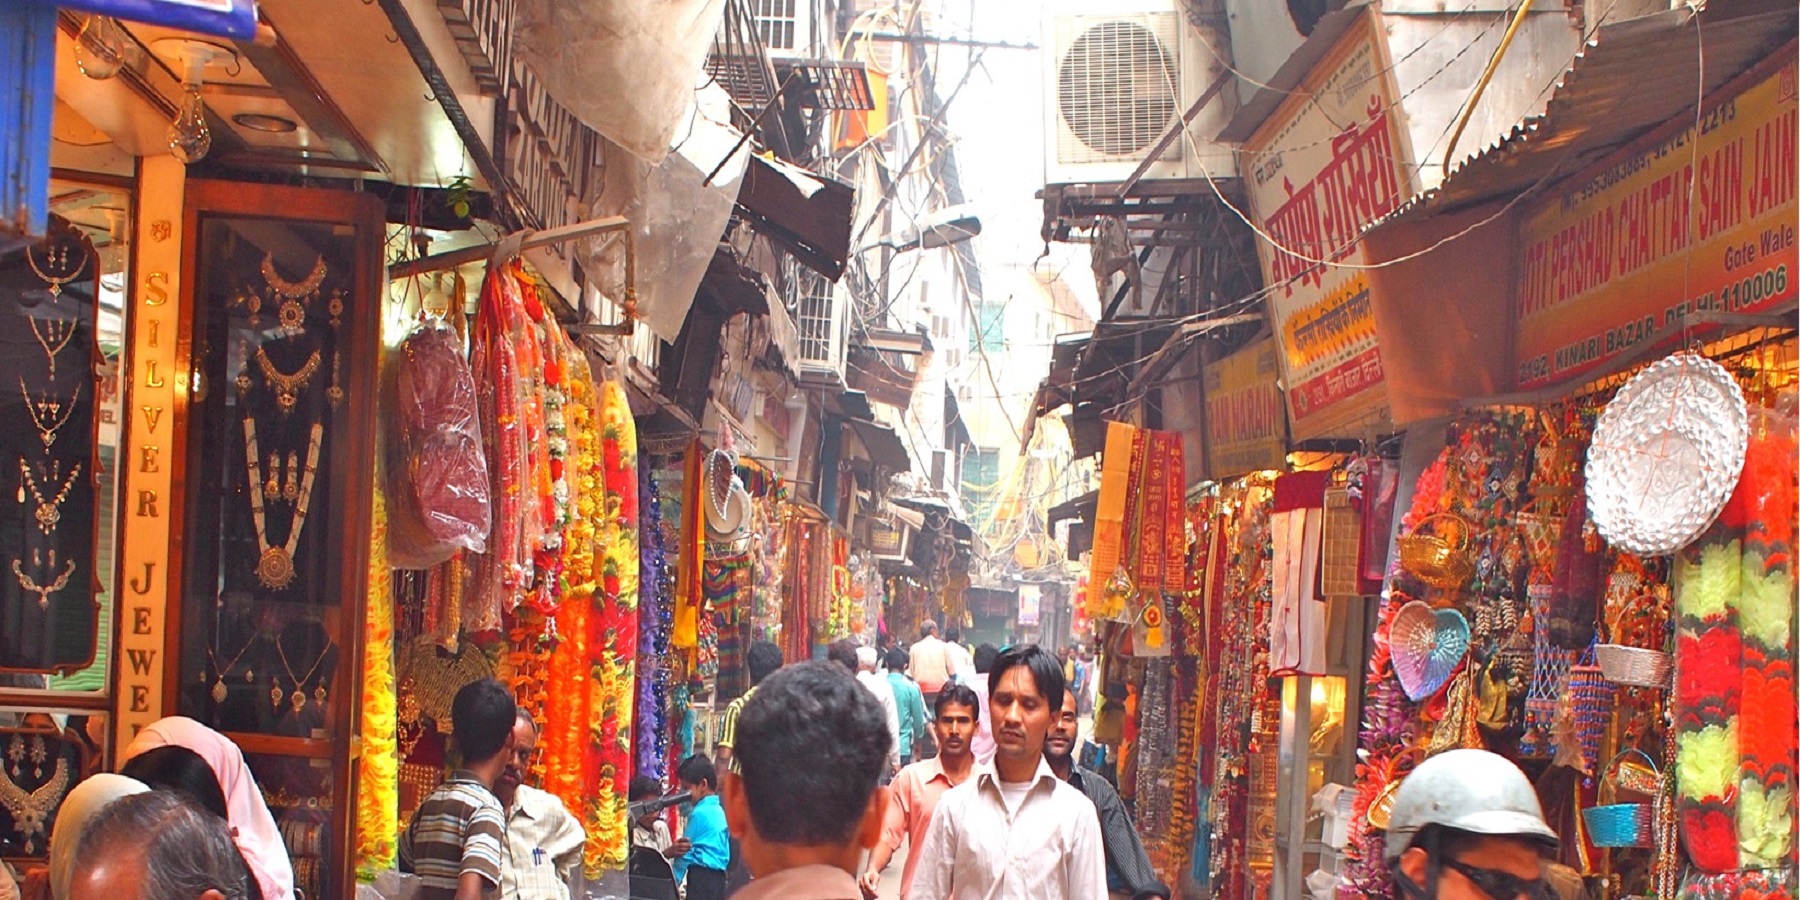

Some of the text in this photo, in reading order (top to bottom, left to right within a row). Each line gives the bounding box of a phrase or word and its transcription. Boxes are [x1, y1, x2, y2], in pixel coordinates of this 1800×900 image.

[1518, 108, 1796, 320] JOTI PERSHAD CHATTAR SAIN JAIN
[1724, 223, 1793, 272] Gote Wale
[136, 272, 169, 518] SILVER
[1555, 336, 1600, 371] KINARI
